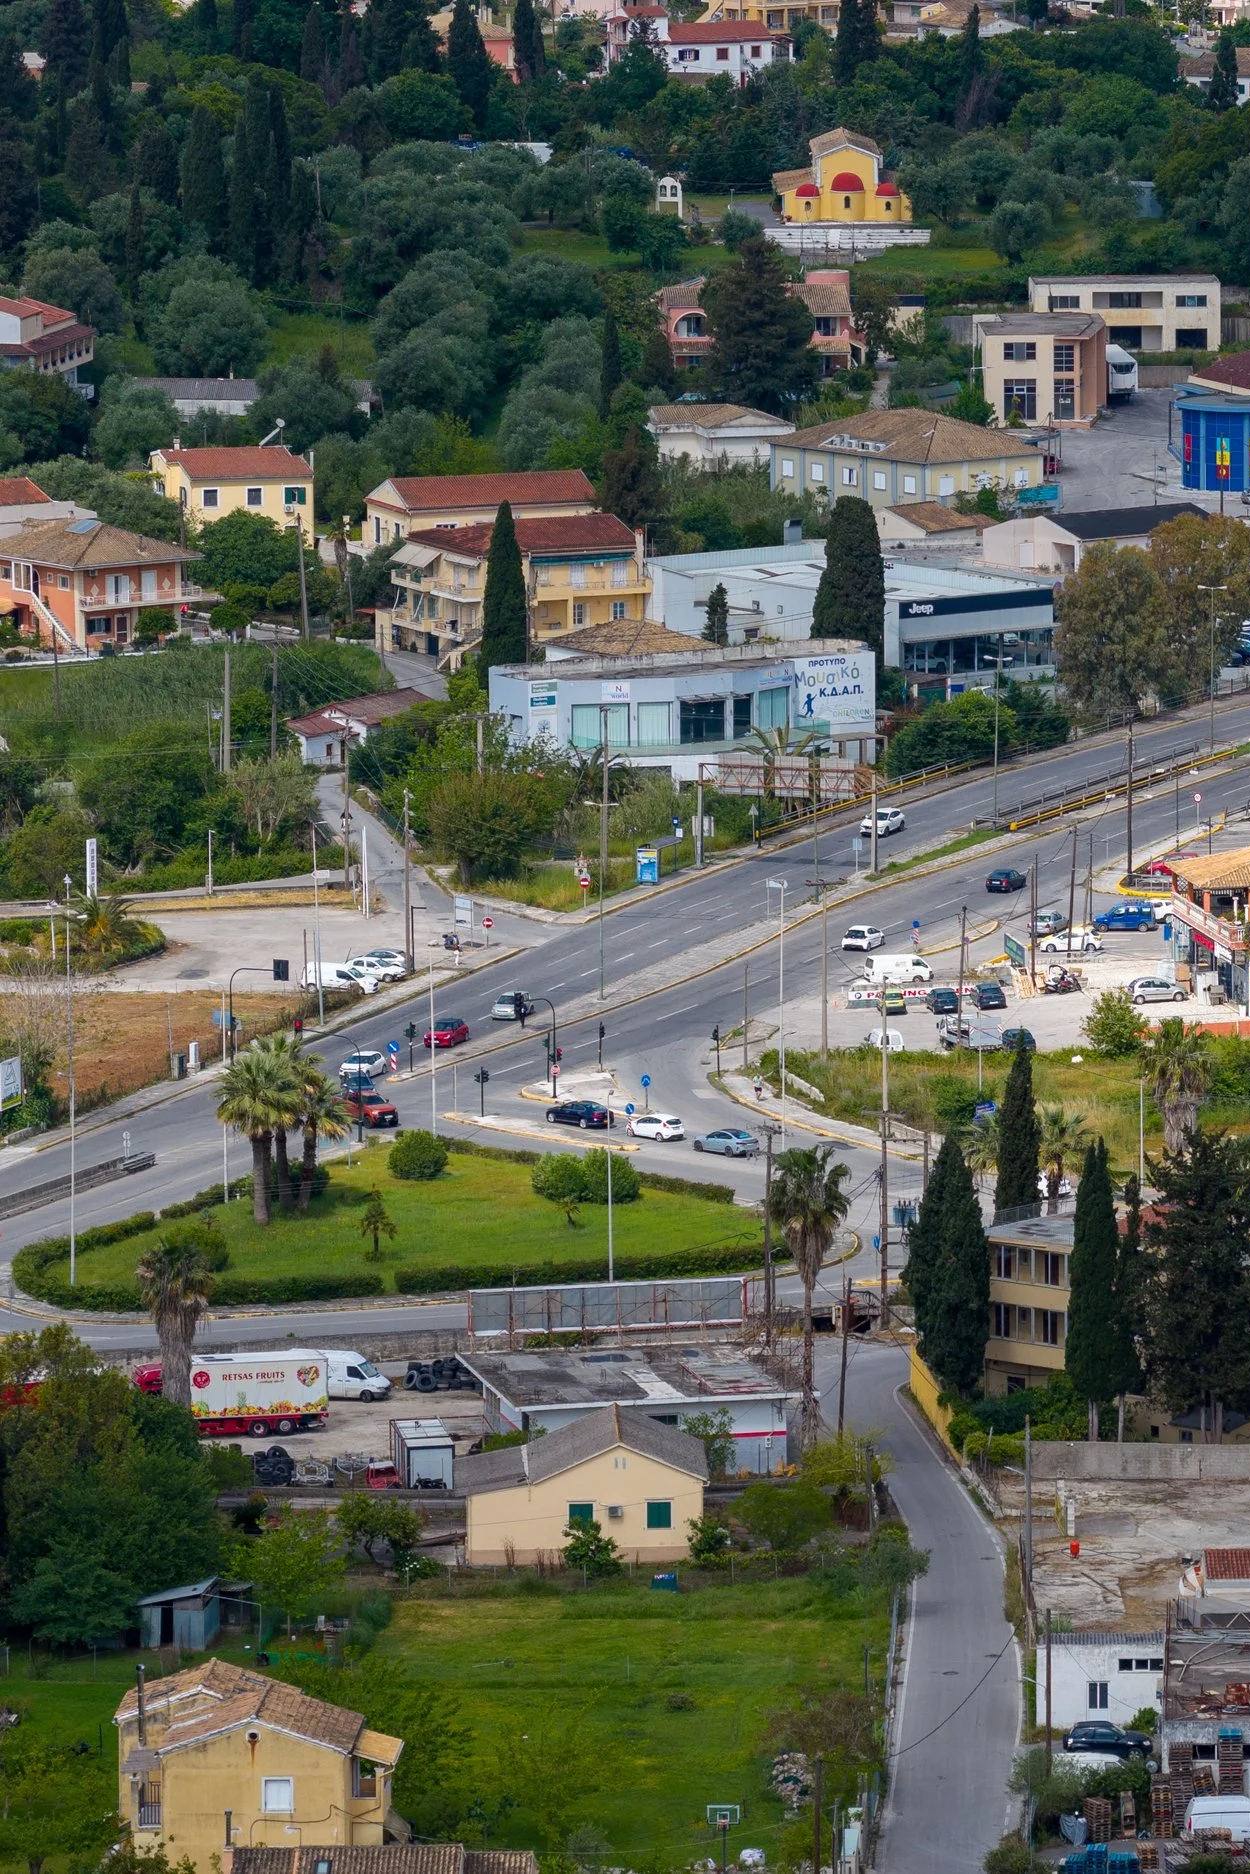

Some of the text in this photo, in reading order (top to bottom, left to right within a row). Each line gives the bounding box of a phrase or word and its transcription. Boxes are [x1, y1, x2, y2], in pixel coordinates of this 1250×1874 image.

[908, 603, 934, 615] Jeep
[808, 657, 847, 668] ΠΡΟΤΥΠΟ
[222, 1371, 285, 1381] RETSAS FRUITS
